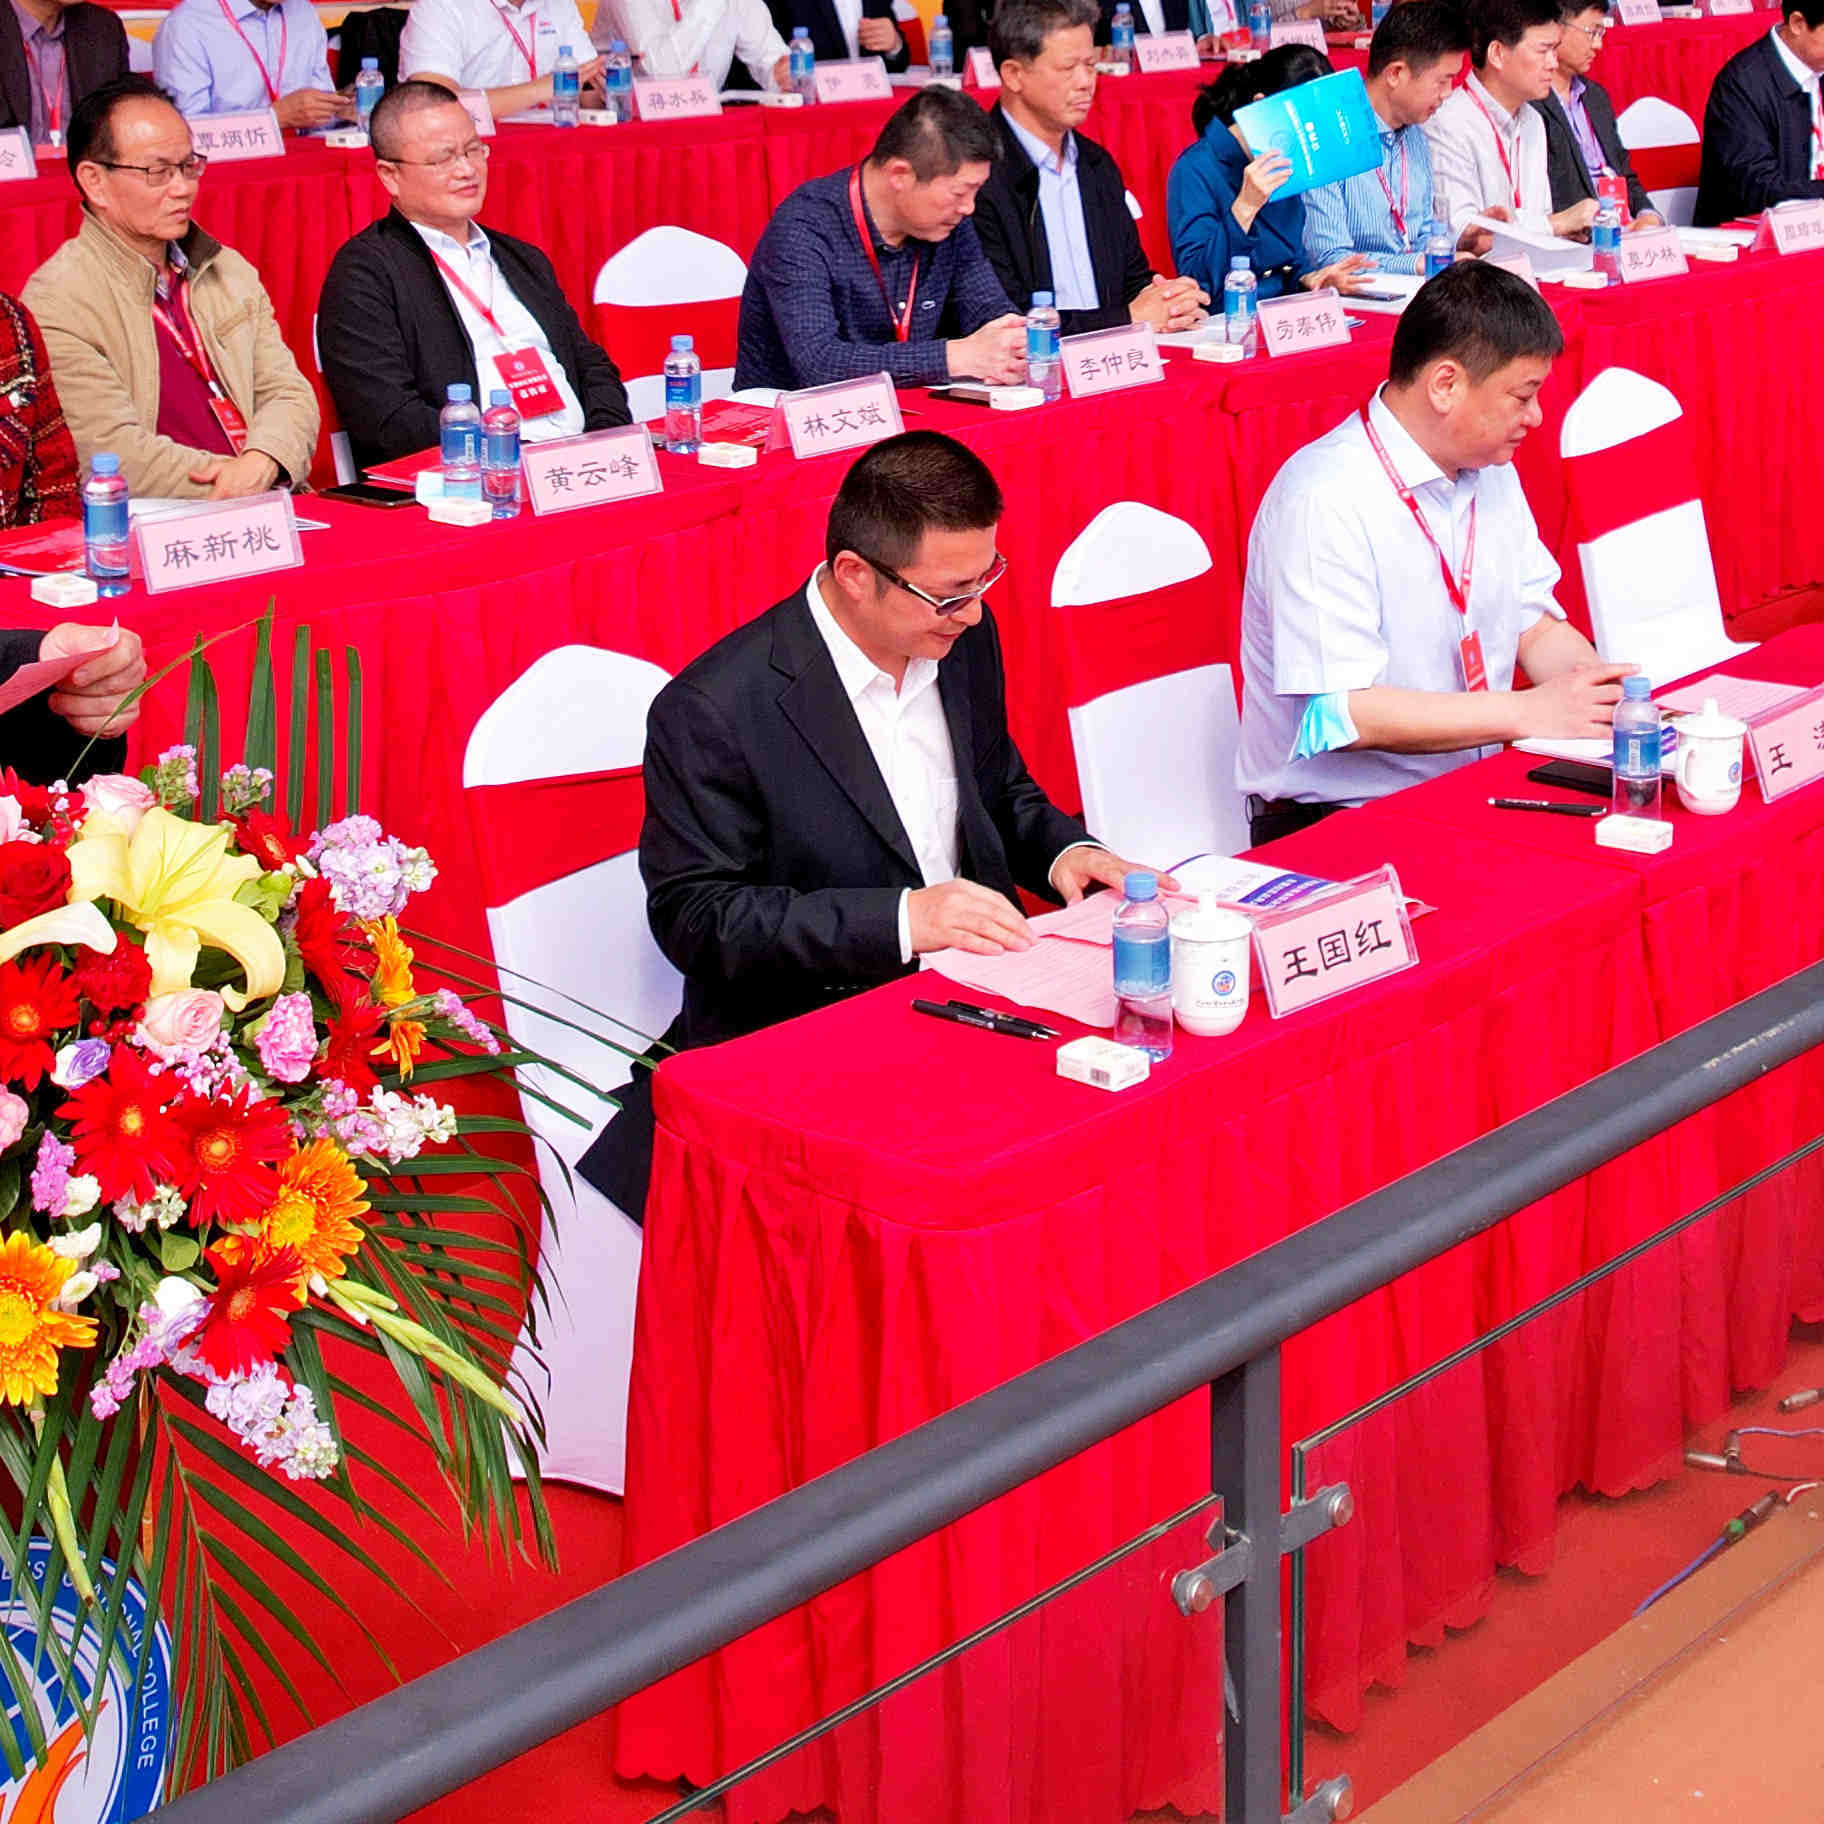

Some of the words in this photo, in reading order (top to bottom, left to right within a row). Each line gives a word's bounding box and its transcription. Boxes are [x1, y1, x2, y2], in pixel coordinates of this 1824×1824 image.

[1079, 347, 1150, 382] 李仲良
[803, 401, 887, 440] 林文斌
[544, 452, 641, 495] 黄云峰
[161, 521, 282, 571] 麻新桃
[1282, 918, 1393, 986] 王国红
